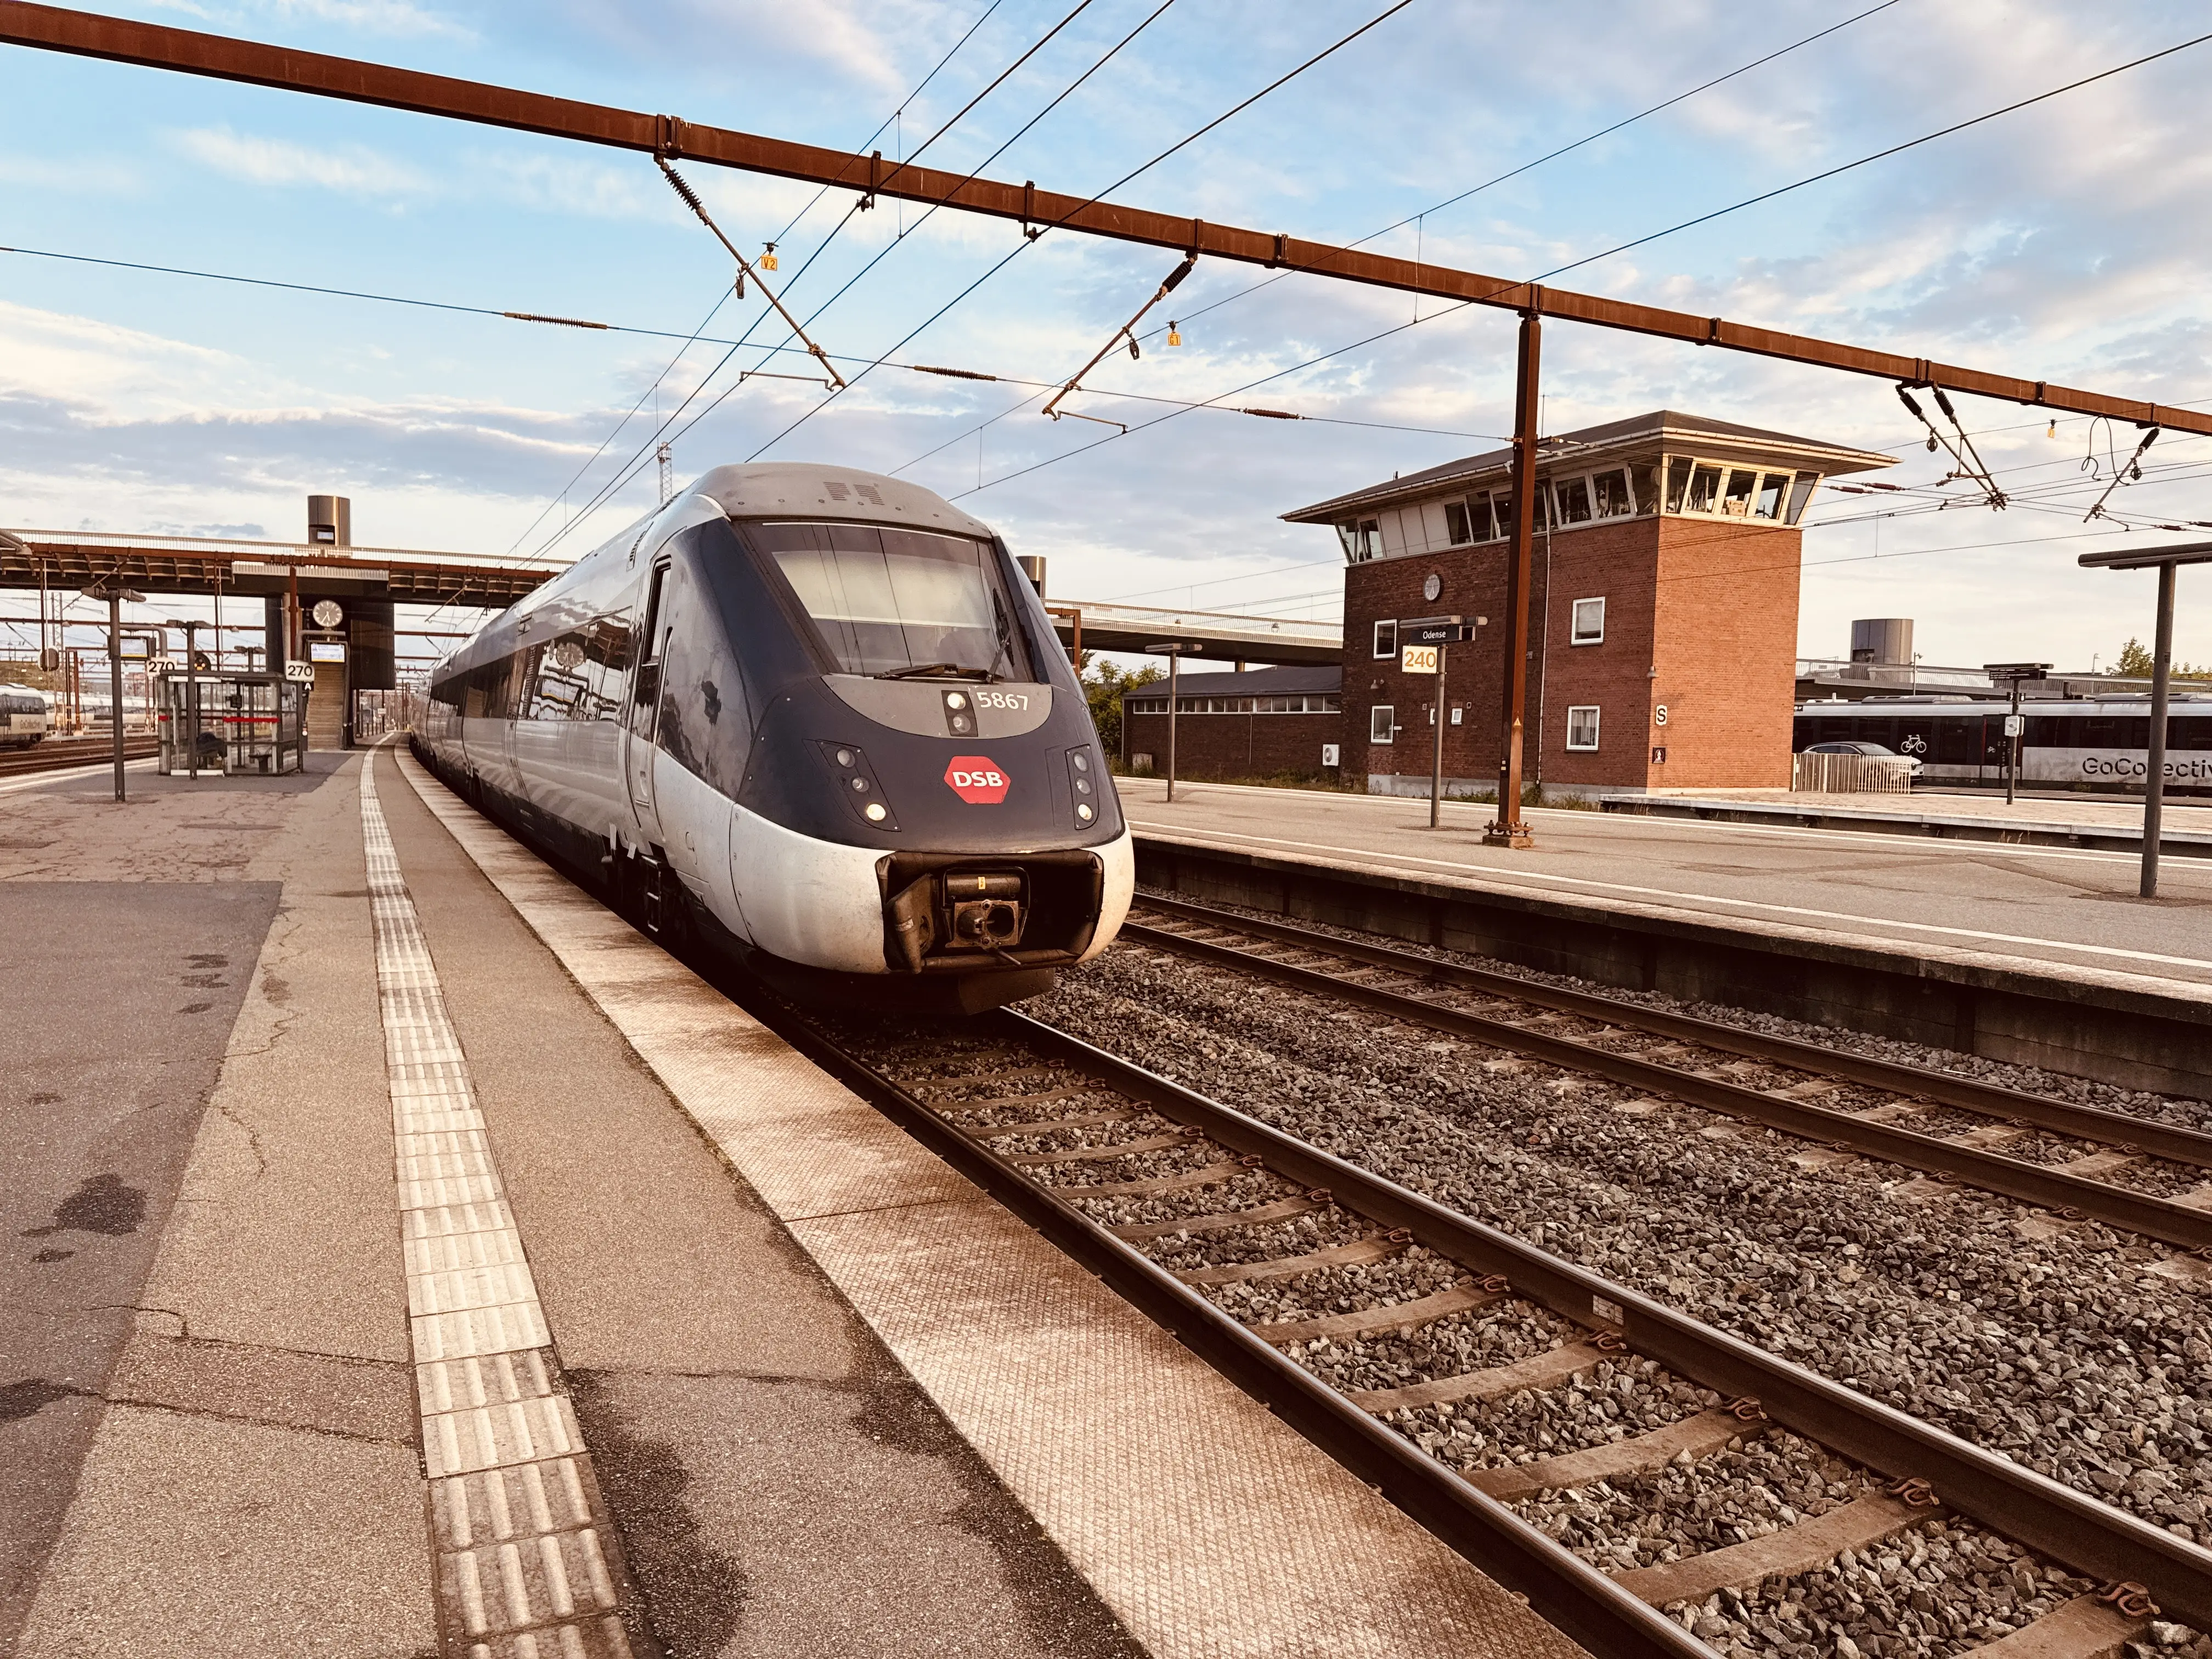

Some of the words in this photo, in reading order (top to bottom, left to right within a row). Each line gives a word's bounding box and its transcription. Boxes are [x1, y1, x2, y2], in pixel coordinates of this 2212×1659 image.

[1423, 630, 1446, 639] Odense
[149, 661, 175, 673] 270
[1404, 651, 1436, 668] 240
[288, 665, 313, 676] 270
[304, 682, 312, 691] A
[977, 692, 1028, 711] 5867
[1657, 708, 1666, 723] S
[2083, 757, 2212, 777] GoCoecti
[952, 771, 1003, 787] DSB
